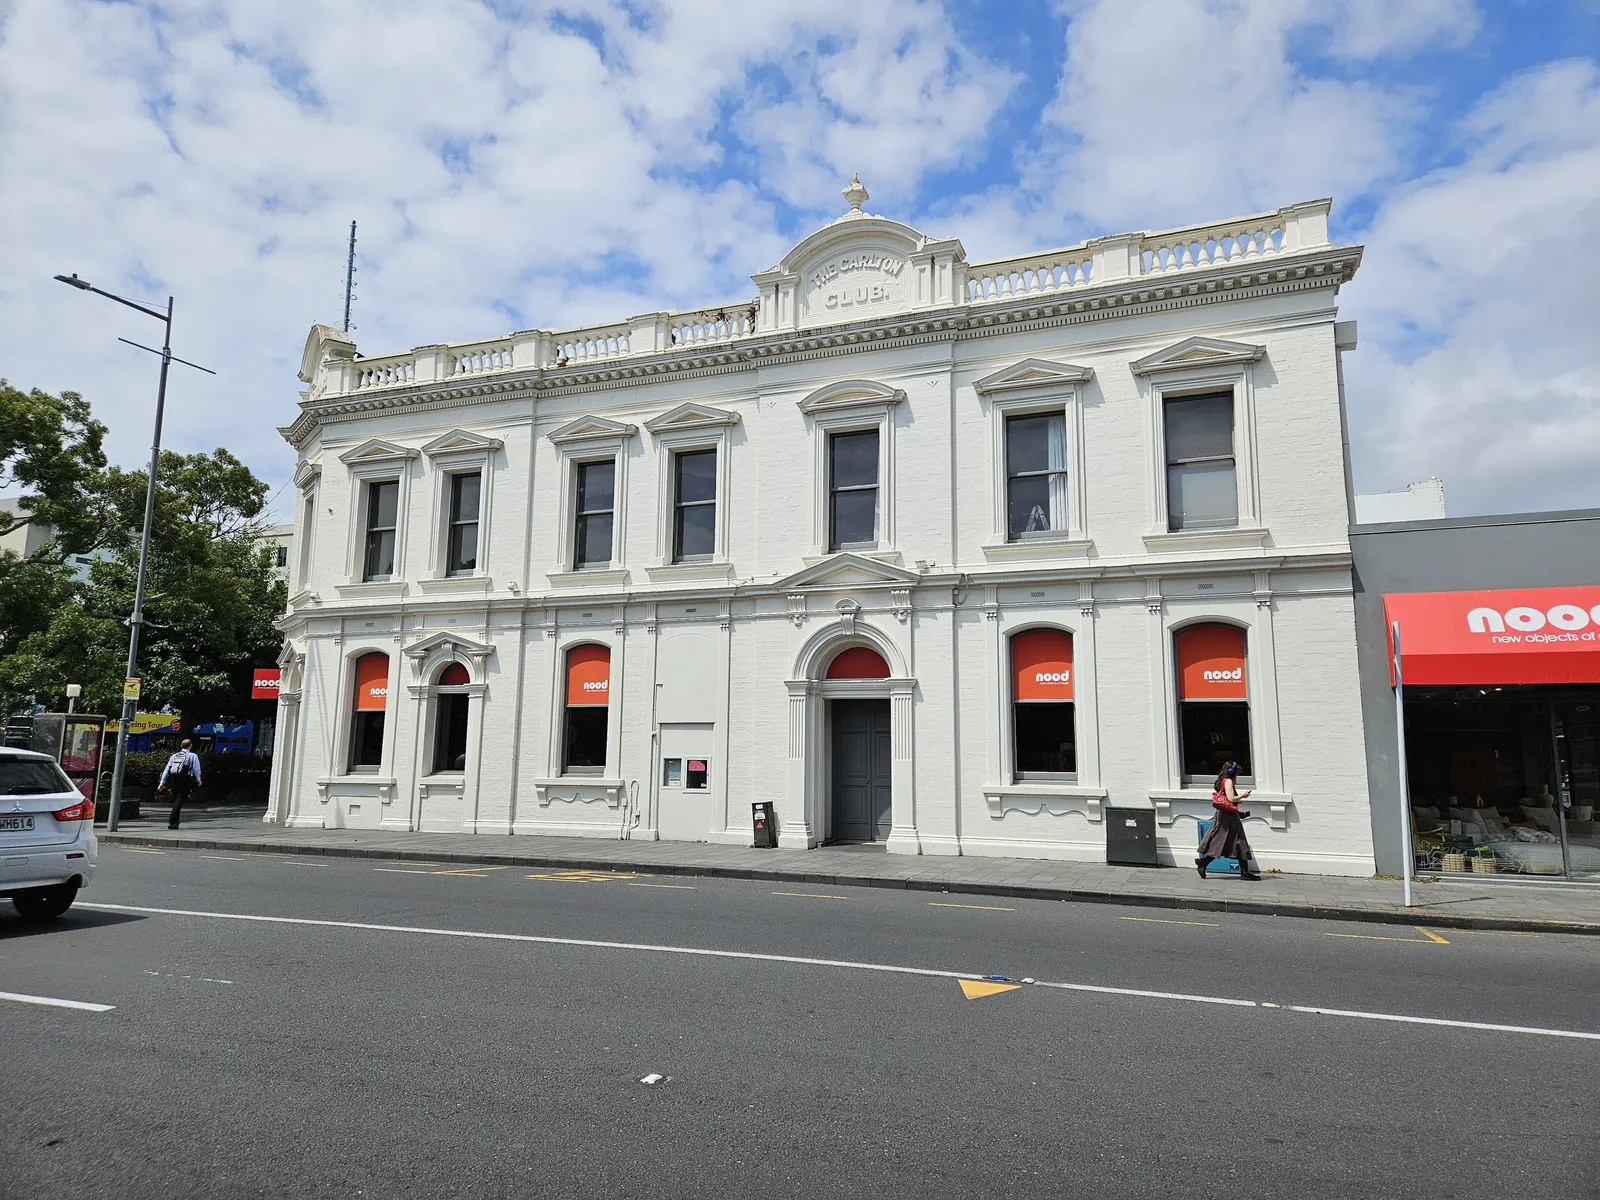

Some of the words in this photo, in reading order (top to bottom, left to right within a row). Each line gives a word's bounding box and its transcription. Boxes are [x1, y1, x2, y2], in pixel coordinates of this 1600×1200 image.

[811, 264, 839, 289] THE
[840, 254, 904, 280] CARLTON
[1467, 604, 1600, 633] noo
[1492, 635, 1522, 644] new
[1525, 633, 1580, 644] objects
[1581, 632, 1596, 641] of
[1035, 669, 1070, 682] nood
[1203, 667, 1243, 680] nood
[583, 679, 609, 690] nood
[370, 687, 388, 696] noo
[147, 721, 164, 729] Tour
